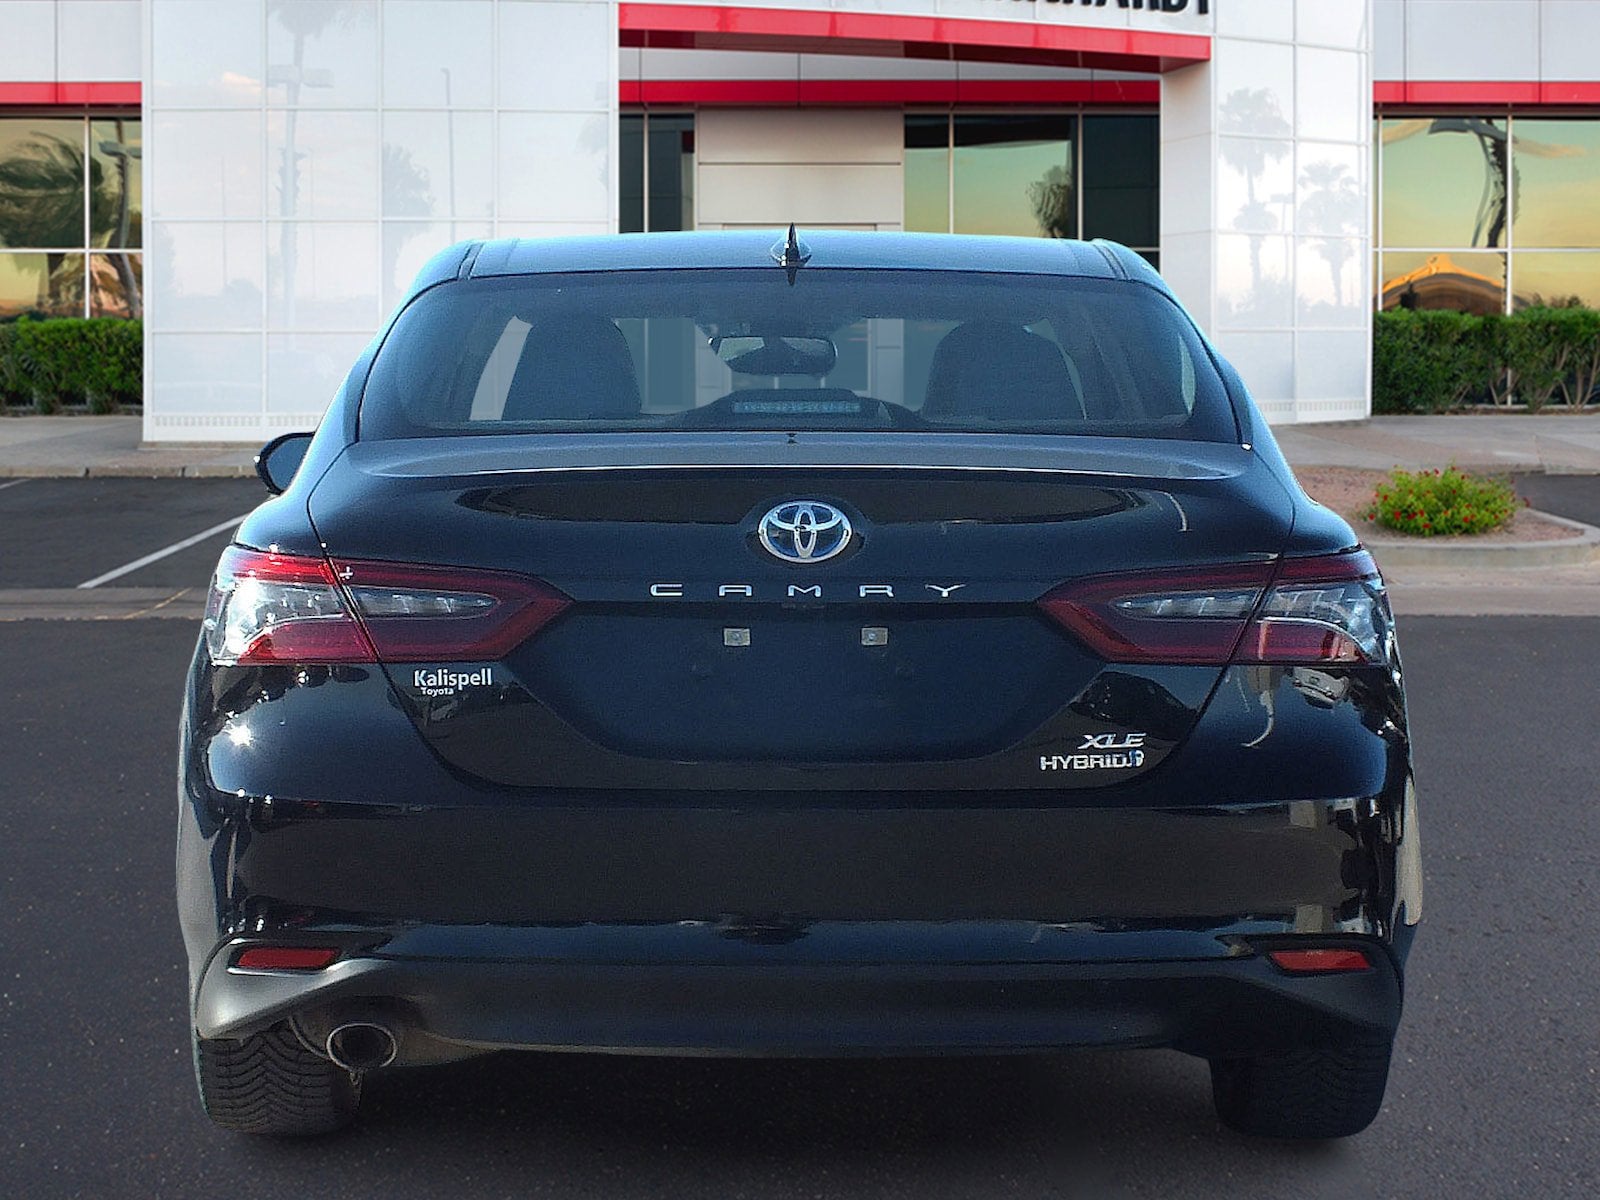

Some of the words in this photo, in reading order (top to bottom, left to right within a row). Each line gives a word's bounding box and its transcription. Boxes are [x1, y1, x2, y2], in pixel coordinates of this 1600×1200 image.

[649, 583, 966, 598] CAMRY
[414, 667, 493, 691] Kalispell
[420, 687, 454, 698] Toyota
[1077, 732, 1147, 749] XLE
[1040, 754, 1129, 770] HYBRID
